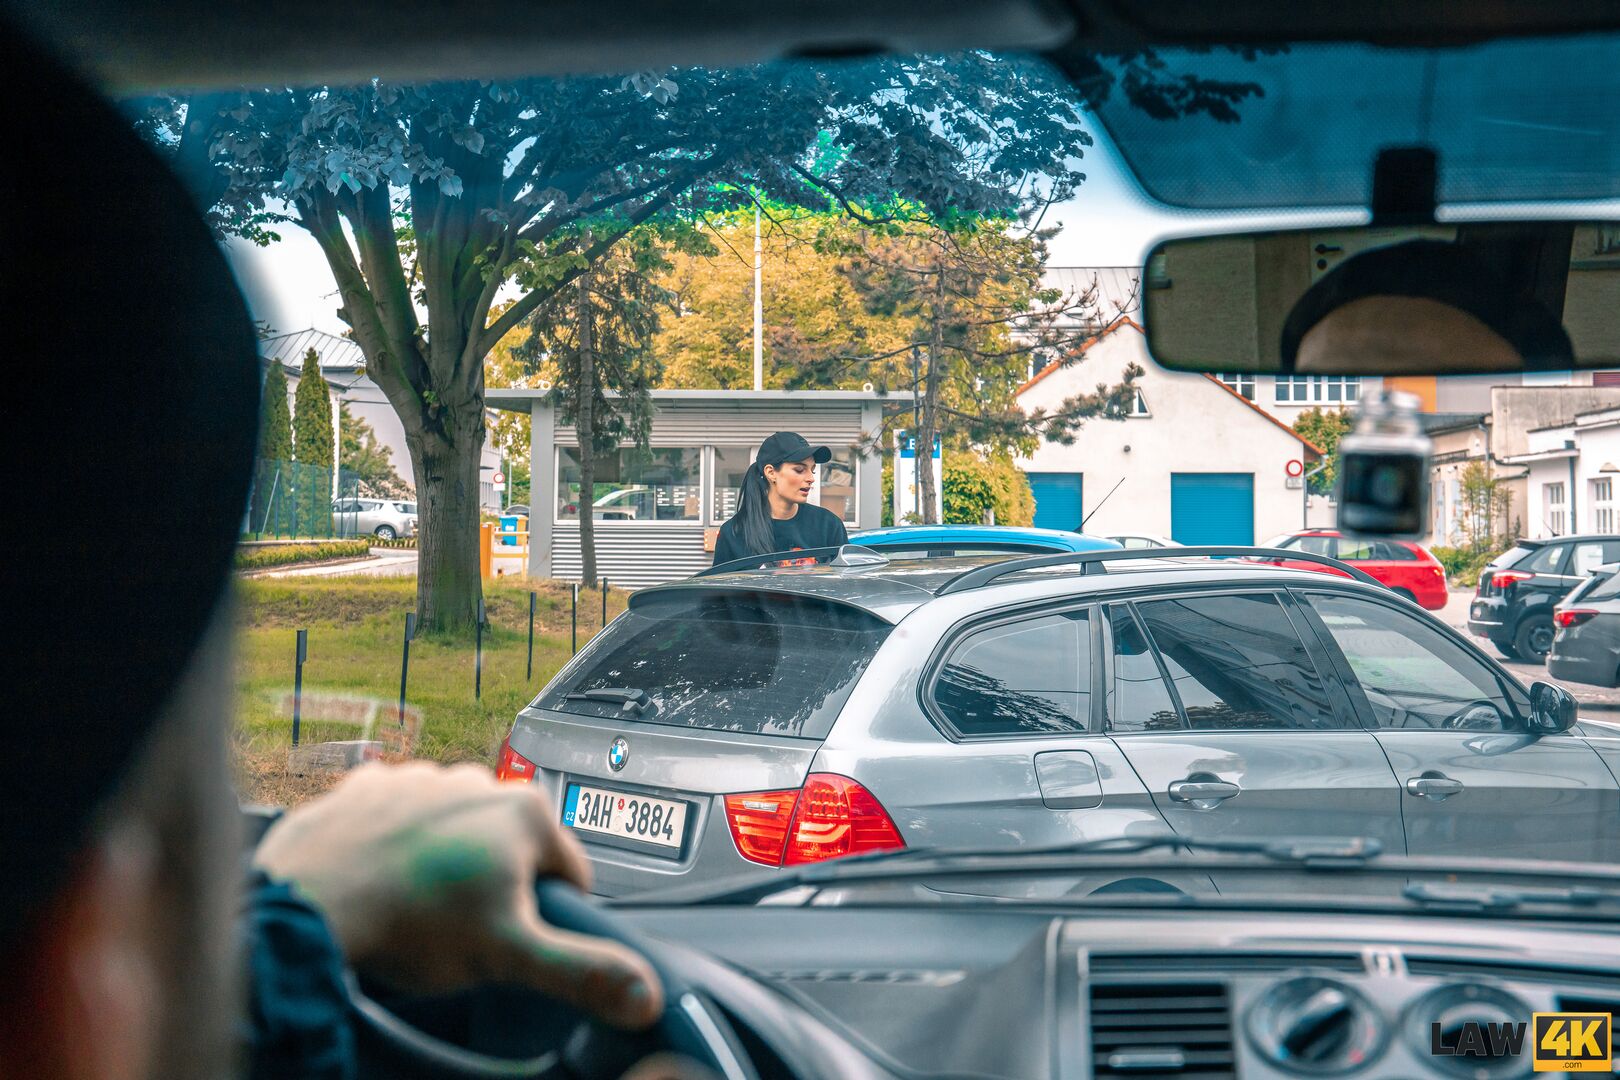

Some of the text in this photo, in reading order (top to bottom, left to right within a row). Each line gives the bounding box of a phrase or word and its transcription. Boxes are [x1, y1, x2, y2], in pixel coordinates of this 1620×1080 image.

[565, 811, 575, 822] CZ
[578, 792, 674, 841] 3AH 3884
